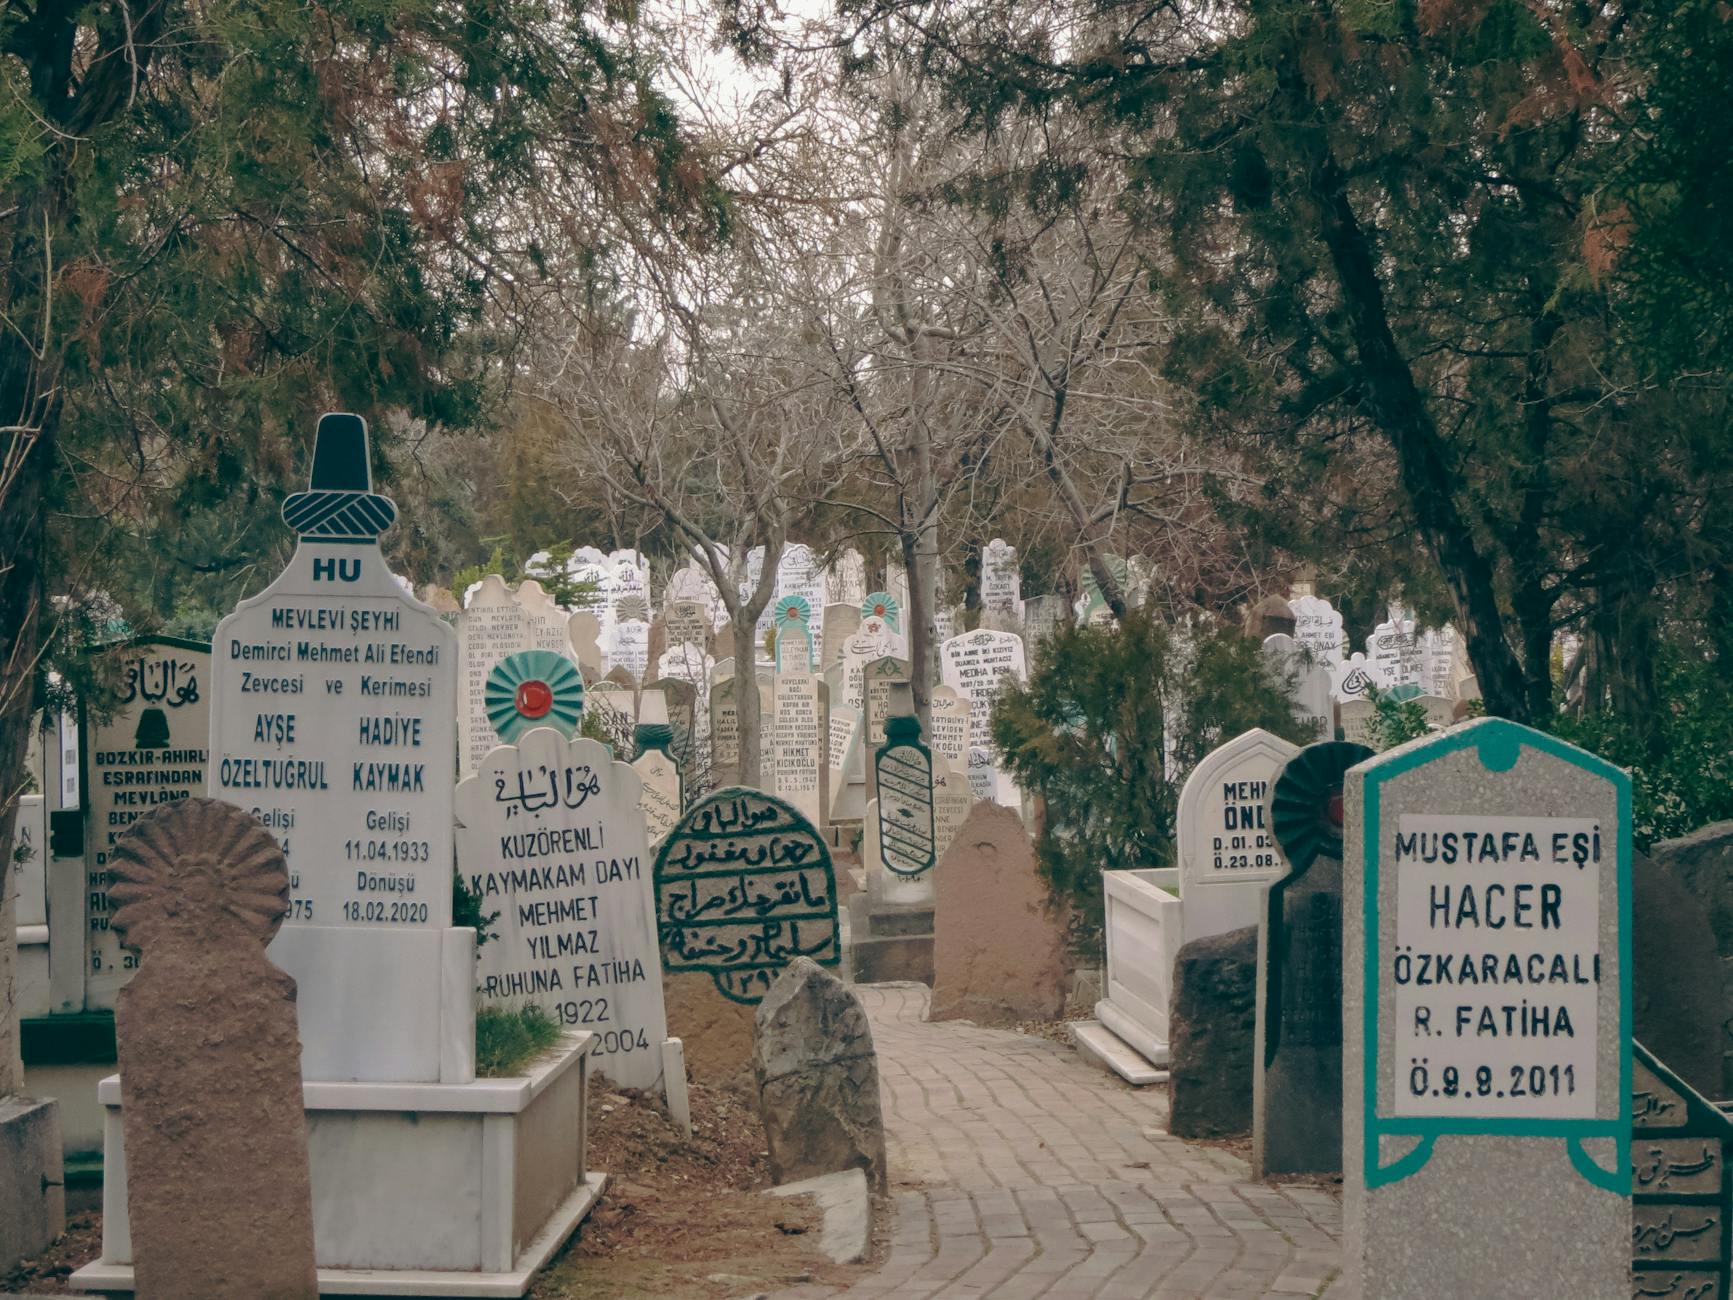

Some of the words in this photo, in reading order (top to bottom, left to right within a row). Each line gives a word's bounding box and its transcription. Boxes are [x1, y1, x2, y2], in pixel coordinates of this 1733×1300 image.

[313, 559, 361, 582] HU
[272, 606, 344, 630] MEVLEVİ
[350, 606, 399, 636] ŞEYHİ
[231, 639, 291, 661] Demirci
[298, 642, 359, 663] Mehmet
[364, 643, 385, 663] Ali
[390, 644, 439, 665] Efendi
[241, 672, 303, 694] Zevcesi
[326, 678, 343, 694] ve
[361, 676, 431, 697] Kerimesi
[254, 714, 295, 750] AYŞE
[360, 712, 421, 746] HADİYE
[220, 753, 328, 790] ÖZELTUĞRUL
[353, 762, 424, 792] KAYMAK
[109, 811, 144, 825] BEN
[366, 811, 410, 836] Gelişi
[344, 840, 429, 862] 11.04.1933
[501, 821, 604, 859] KUZÖRENLİ
[1395, 832, 1540, 864] MUSTAFA
[1551, 825, 1600, 869] EŞİ
[1214, 852, 1284, 869] Ö.23.08.
[357, 871, 415, 897] Dönüşü
[472, 862, 585, 897] KAYMAKAM
[596, 857, 641, 885] DAYI
[343, 901, 428, 923] 18.02.2020
[518, 896, 599, 927] MEHMET
[1430, 883, 1562, 929] HACER
[527, 930, 600, 960] YILMAZ
[486, 968, 563, 999] RUHUNA
[573, 957, 646, 988] FATİHA
[1394, 946, 1600, 986] ÖZKARACALI
[555, 998, 610, 1025] 1922
[1415, 1005, 1442, 1037] R.
[1456, 999, 1574, 1038] FATİHA
[591, 1028, 649, 1057] 2004
